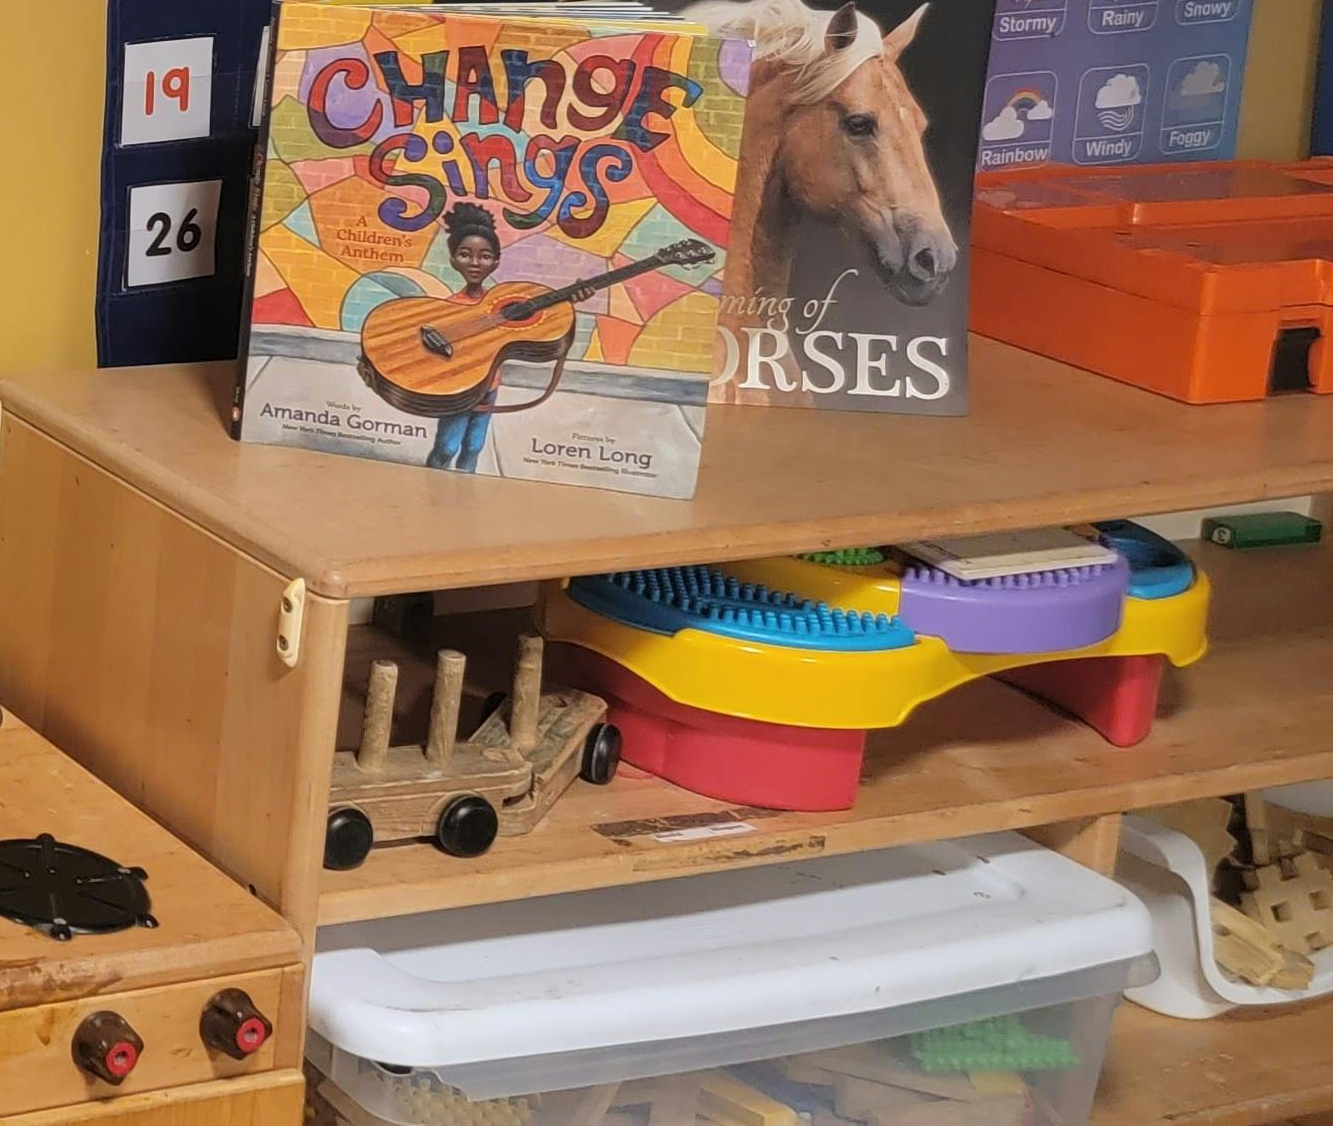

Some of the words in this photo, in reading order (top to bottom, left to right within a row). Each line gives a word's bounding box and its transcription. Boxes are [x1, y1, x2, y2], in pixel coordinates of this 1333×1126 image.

[1102, 10, 1143, 28] Rainy
[1185, 2, 1232, 18] Snowy
[999, 15, 1056, 34] Stormy
[145, 67, 190, 116] 19
[1169, 130, 1210, 147] Foggy
[981, 148, 1048, 166] Rainbow
[1086, 139, 1132, 157] Windy
[369, 129, 633, 238] Sings
[145, 208, 204, 258] 26
[337, 229, 412, 247] Children's
[341, 245, 404, 262] Anthem
[796, 269, 859, 334] of
[261, 403, 341, 426] Amanda
[347, 415, 427, 439] Gorman
[532, 439, 591, 460] Loren
[600, 448, 652, 469] Long
